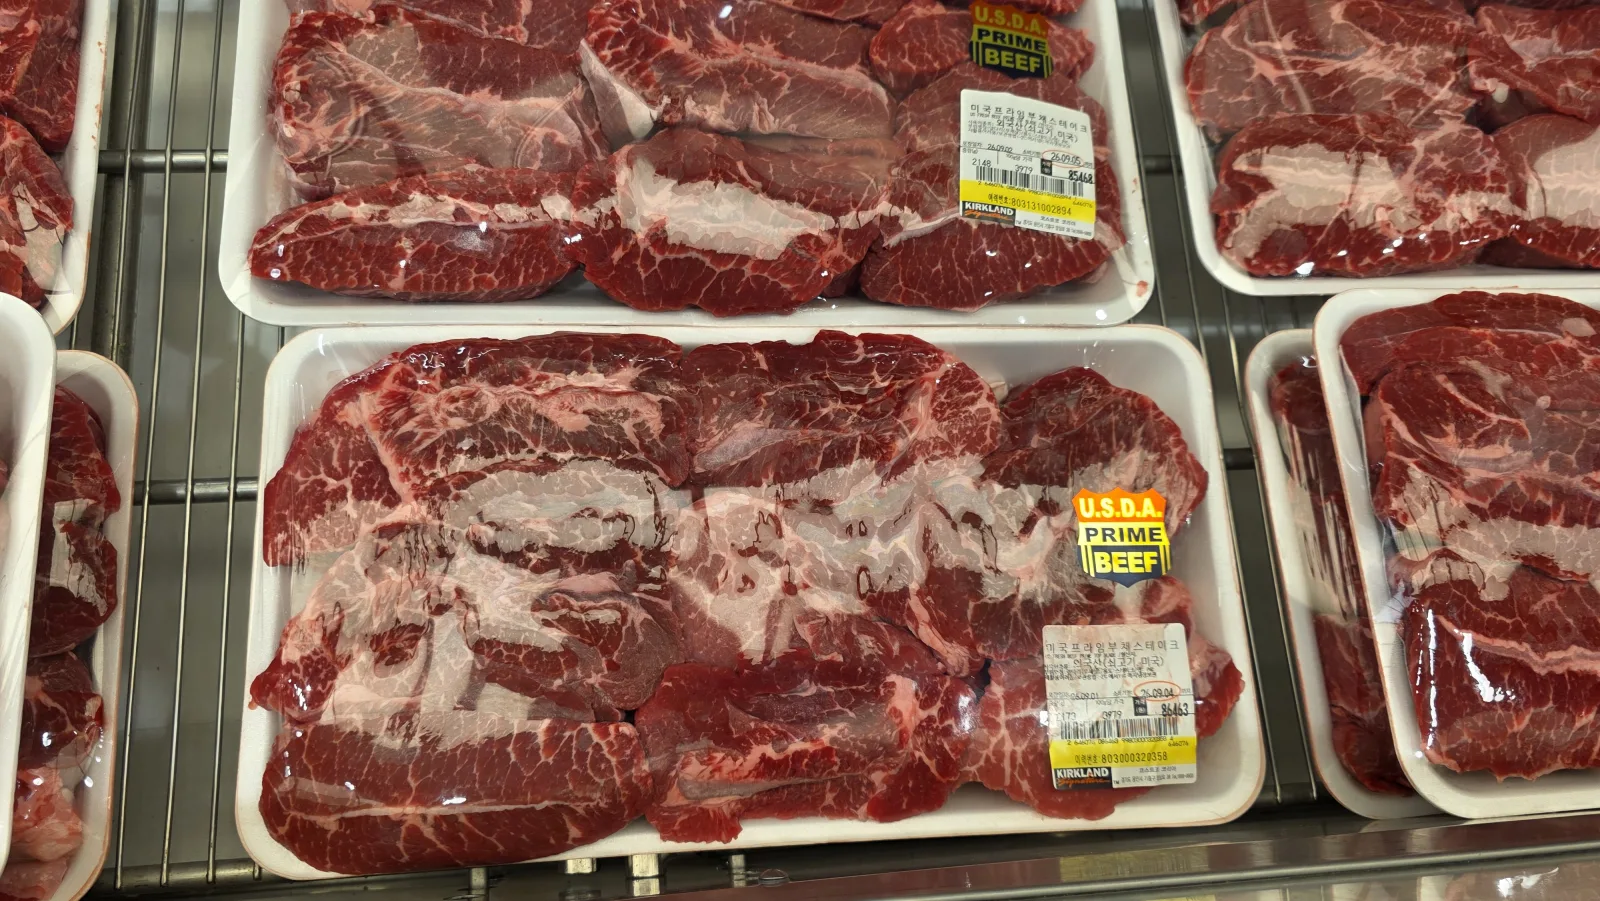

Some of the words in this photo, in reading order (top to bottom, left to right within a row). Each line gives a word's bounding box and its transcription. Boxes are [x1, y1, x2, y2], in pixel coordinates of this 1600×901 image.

[975, 5, 1047, 36] U.S.D.A.
[977, 28, 1047, 54] PRIME
[985, 47, 1041, 73] BEEF
[987, 143, 1013, 154] 26.09.02
[972, 158, 991, 168] 2148
[1051, 152, 1081, 166] 26.09.05
[1014, 164, 1034, 175] 3979
[1068, 169, 1094, 184] 85468
[965, 202, 1014, 216] KIRKLAND
[1079, 498, 1163, 518] U.S.D.A.
[1085, 528, 1163, 542] PRIME
[1093, 552, 1158, 573] BEEF
[1141, 688, 1173, 698] 26.09.04
[1161, 702, 1189, 717] 86463
[1057, 768, 1109, 779] KIRKLAND
